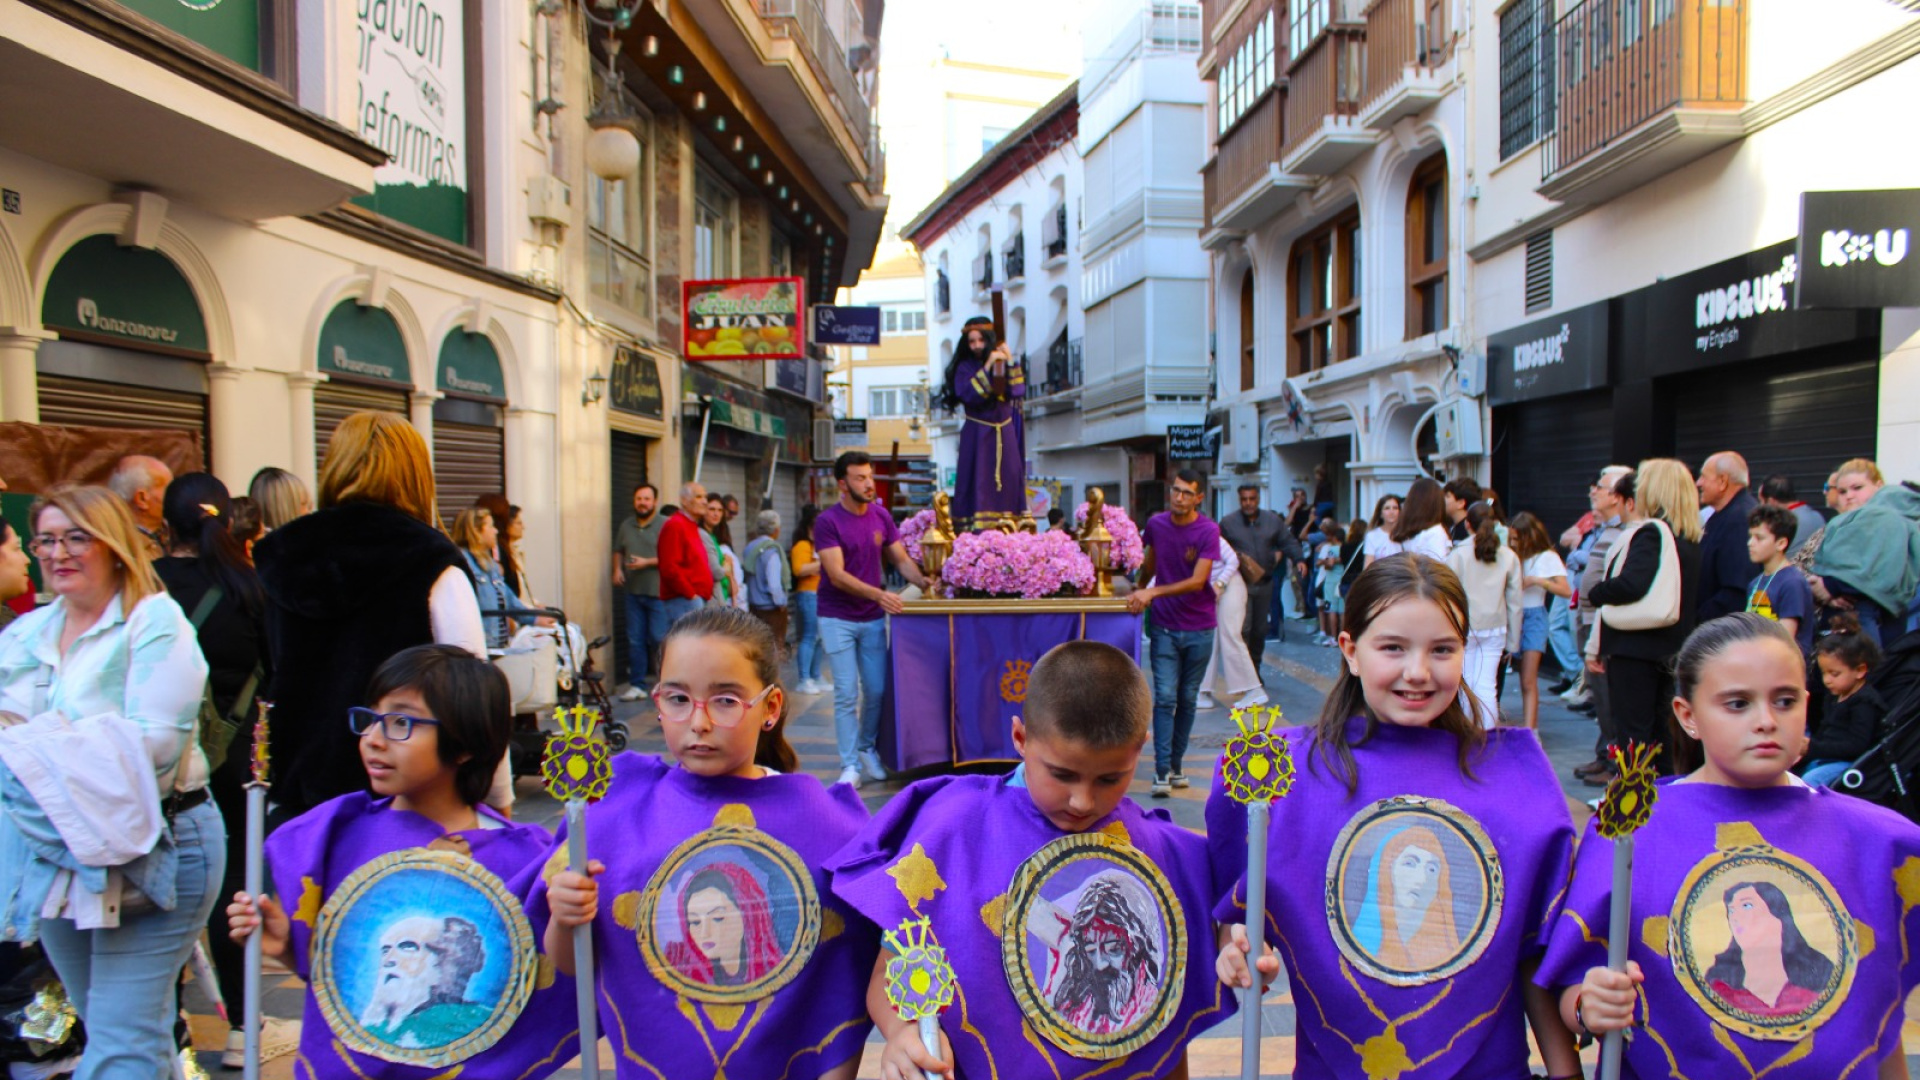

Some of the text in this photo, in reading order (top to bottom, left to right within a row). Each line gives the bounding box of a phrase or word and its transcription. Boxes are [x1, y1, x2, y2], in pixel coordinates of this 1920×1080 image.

[77, 297, 178, 342] Manzanares
[695, 314, 787, 330] JUAN
[1709, 326, 1739, 349] English
[1170, 426, 1205, 437] Miguel
